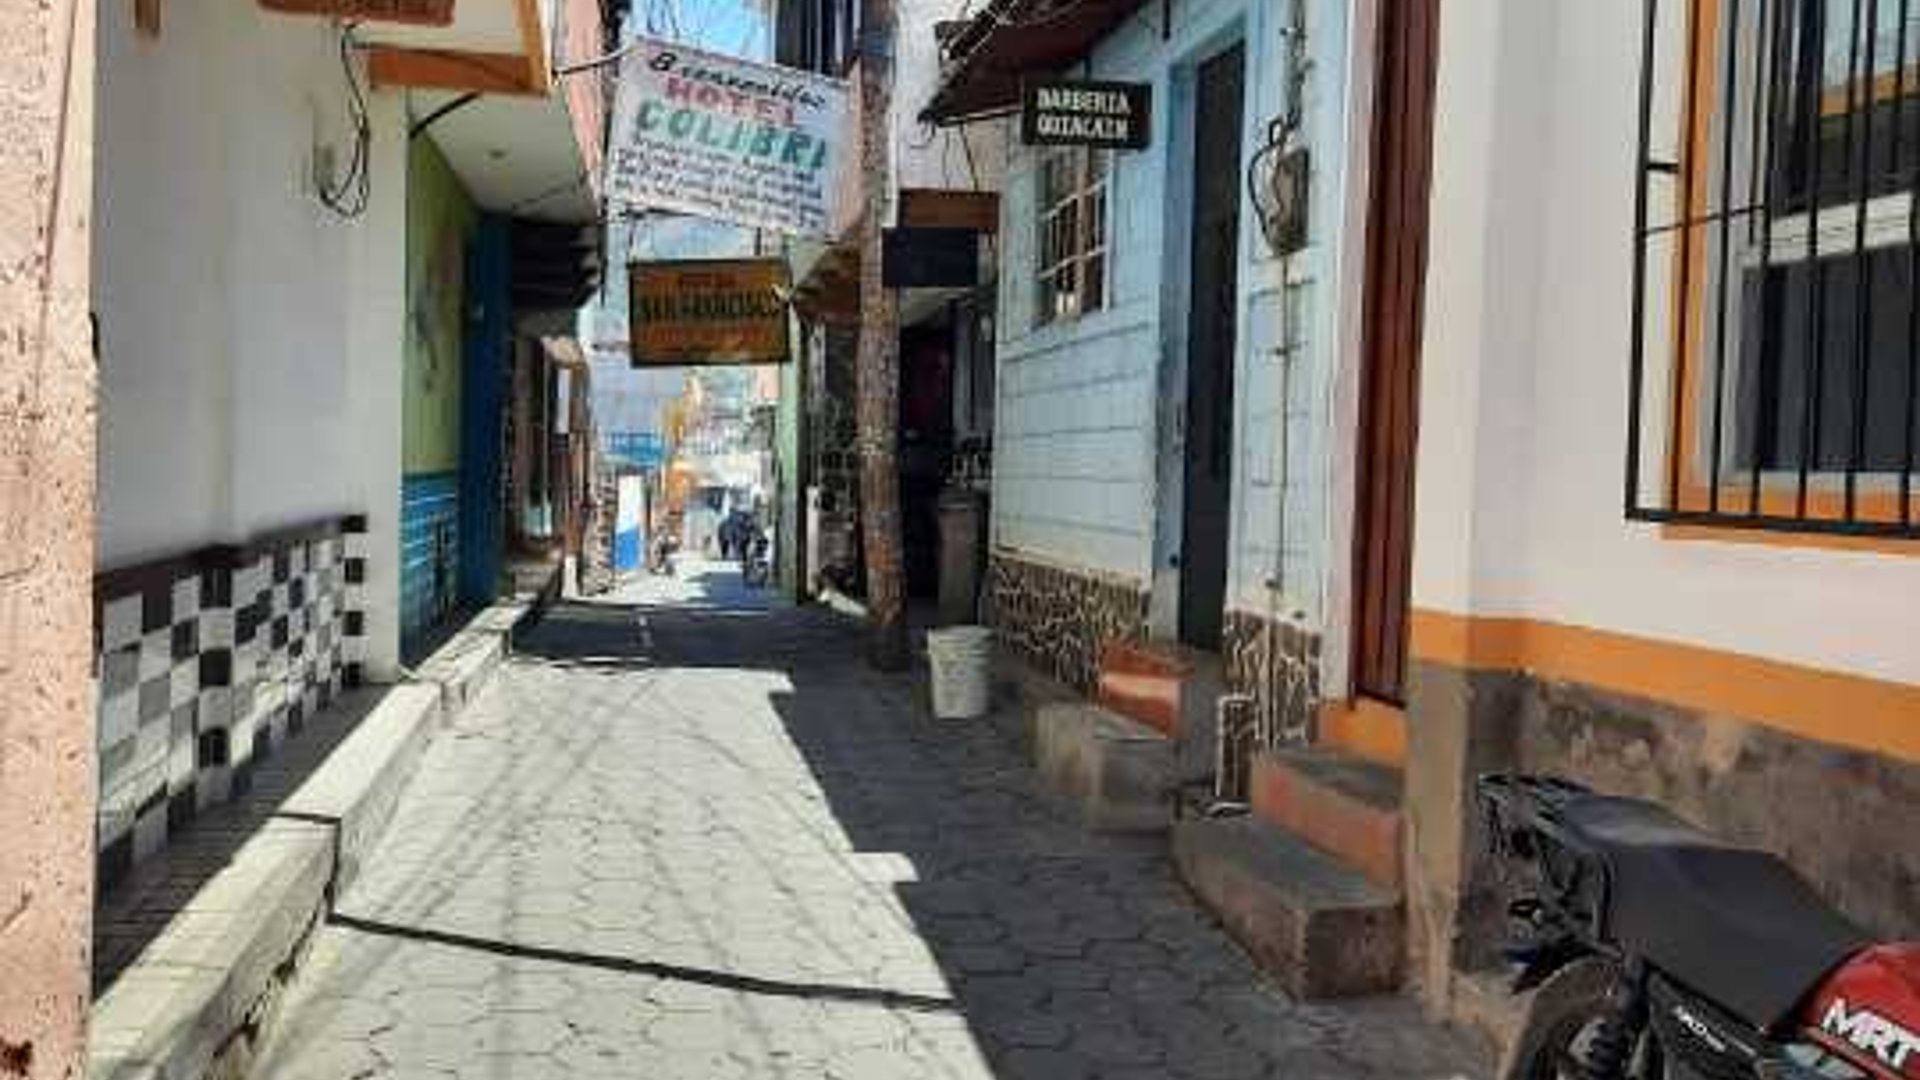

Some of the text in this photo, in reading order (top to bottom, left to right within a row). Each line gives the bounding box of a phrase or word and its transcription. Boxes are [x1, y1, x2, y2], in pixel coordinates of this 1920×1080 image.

[636, 99, 827, 170] COLIBRI
[666, 76, 796, 126] HOTEL
[1821, 996, 1920, 1069] MRT
